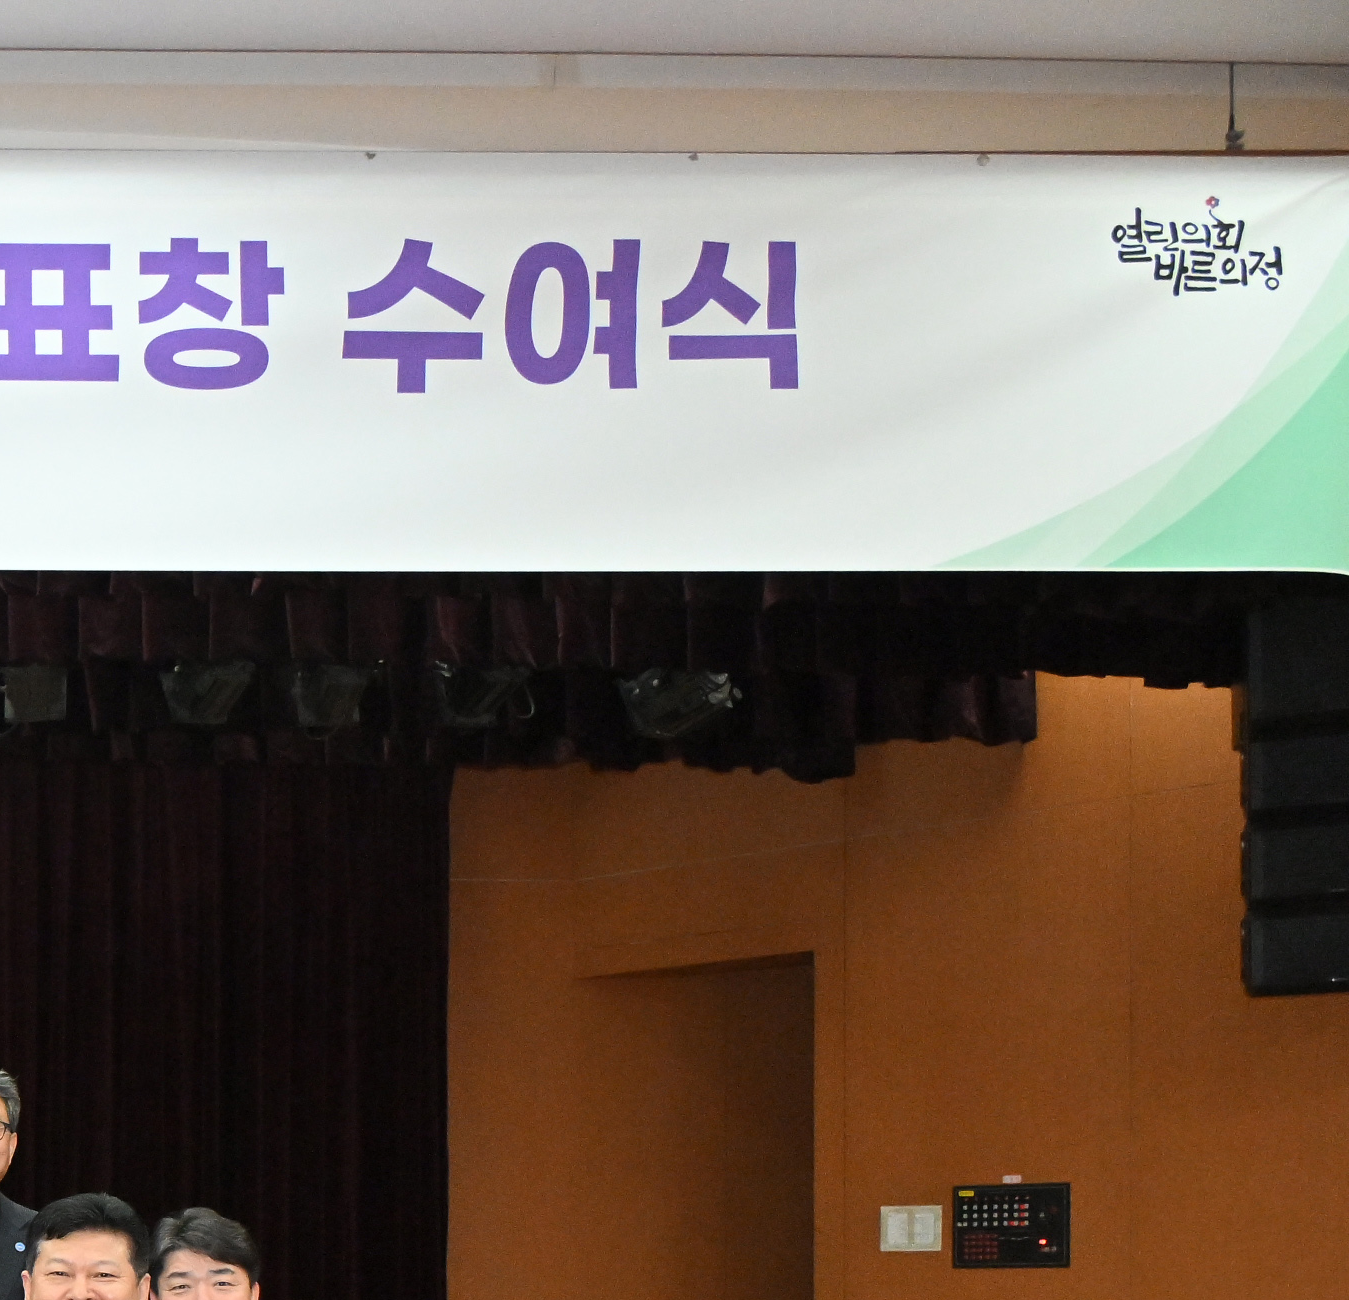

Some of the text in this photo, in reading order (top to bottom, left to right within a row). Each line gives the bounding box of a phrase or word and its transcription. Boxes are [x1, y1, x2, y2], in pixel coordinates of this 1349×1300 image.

[1111, 207, 1245, 263] 열린의회
[1154, 246, 1283, 297] 바른의정
[341, 238, 799, 393] 수여식
